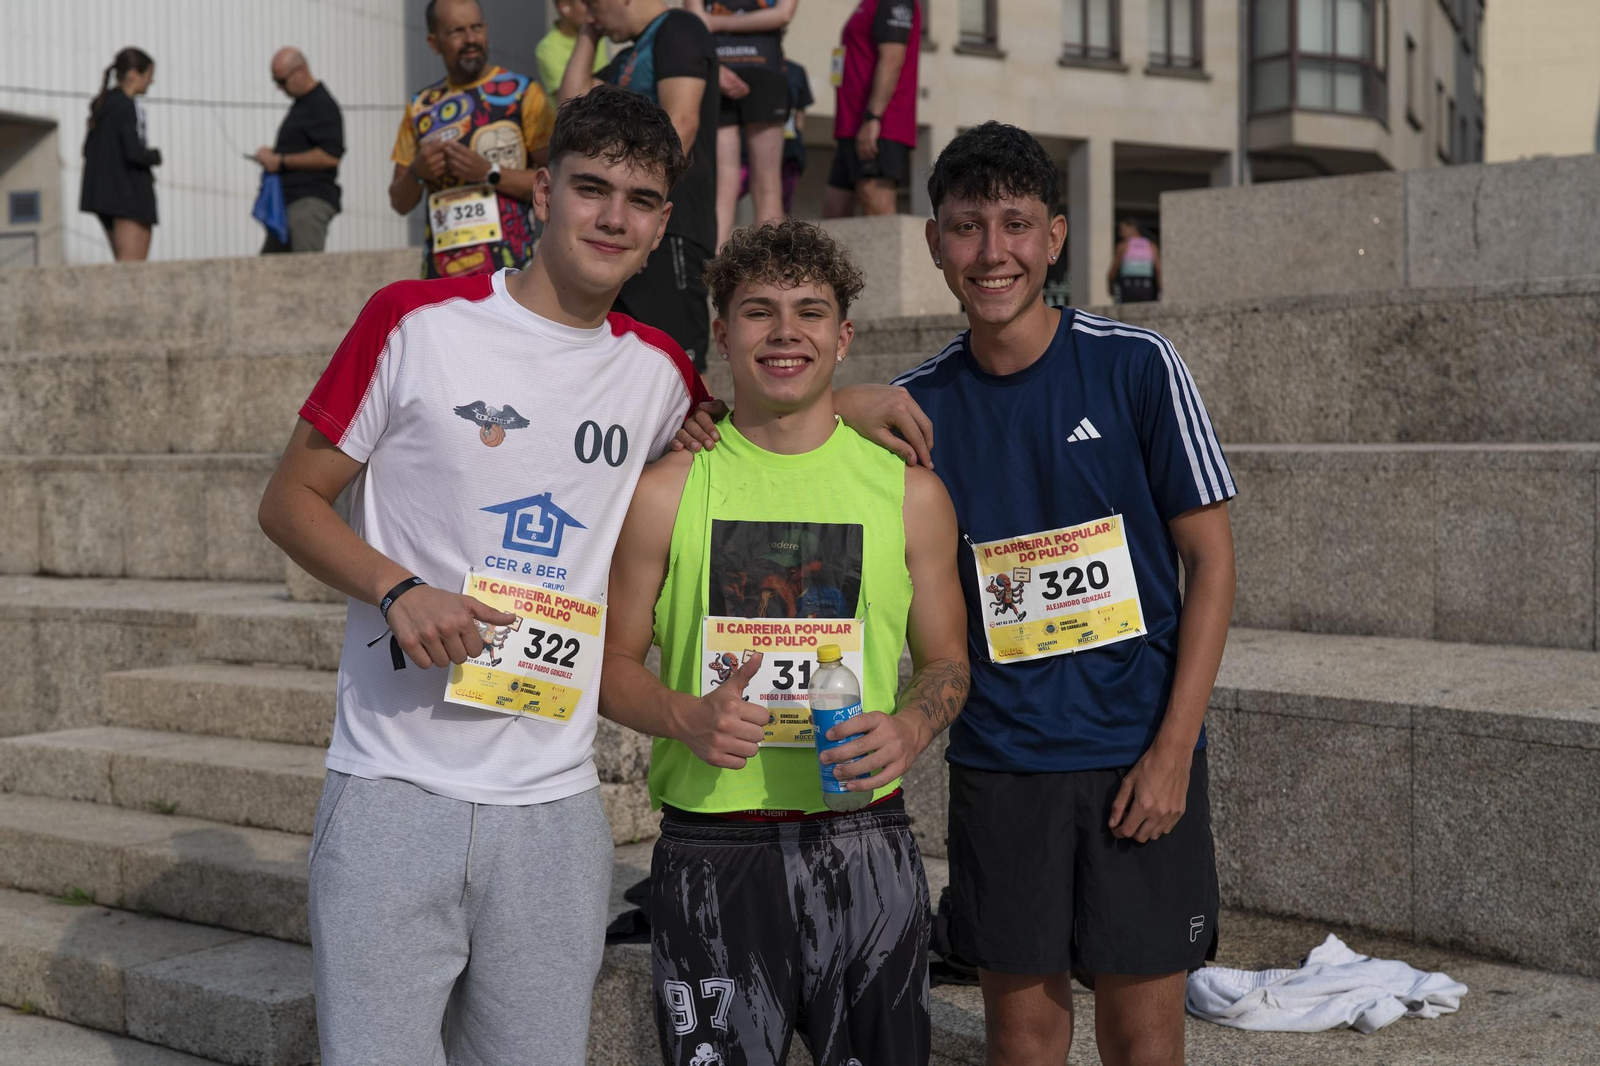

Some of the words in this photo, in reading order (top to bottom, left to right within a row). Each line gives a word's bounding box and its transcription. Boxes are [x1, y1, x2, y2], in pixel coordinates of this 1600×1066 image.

[454, 203, 485, 220] 328
[574, 420, 628, 467] 00
[994, 537, 1053, 557] CARREIRA
[1054, 522, 1112, 545] POPULAR
[1019, 552, 1036, 563] DO
[1039, 543, 1080, 560] PULPO
[485, 555, 518, 572] CER
[521, 562, 532, 574] &
[536, 564, 567, 580] BER
[542, 582, 565, 591] GRUPO
[1039, 560, 1110, 601] 320
[490, 582, 552, 605] CARREIRA
[554, 596, 598, 618] POPULAR
[1046, 597, 1081, 612] ALEJANDRO
[1081, 591, 1112, 605] GONZALEZ
[514, 599, 534, 613] DO
[535, 605, 571, 622] PULPO
[727, 623, 791, 635] CARREIRA
[794, 623, 852, 635] POPULAR
[523, 627, 581, 668] 322
[752, 636, 772, 646] DO
[775, 636, 817, 647] PULPO
[1037, 640, 1058, 648] VITAMIN
[1077, 634, 1099, 645] NOCCO
[533, 664, 550, 674] PARDO
[550, 668, 573, 680] GONZALEZ
[760, 693, 779, 701] DIEGO
[780, 693, 812, 701] FERNAND
[847, 704, 863, 715] VITA
[760, 809, 787, 817] Klein
[664, 977, 735, 1036] 97
